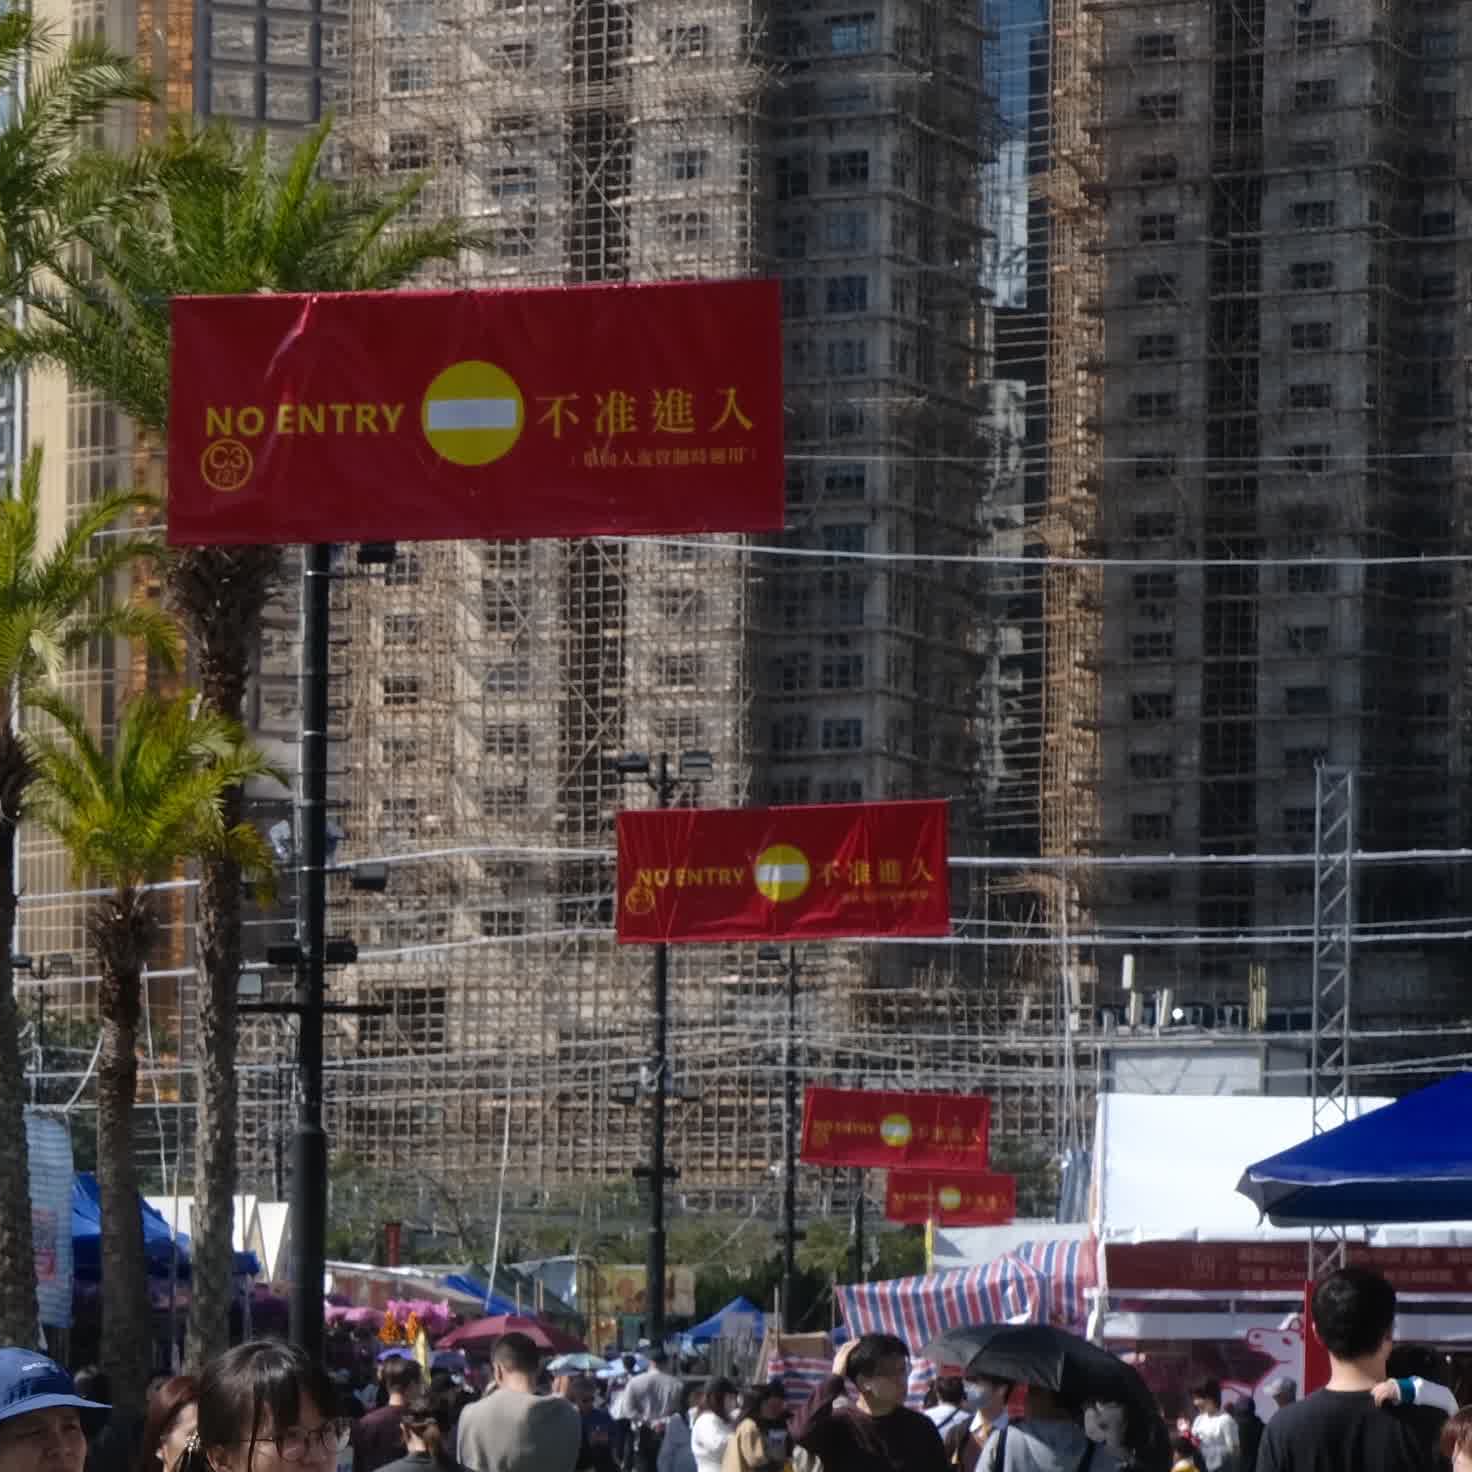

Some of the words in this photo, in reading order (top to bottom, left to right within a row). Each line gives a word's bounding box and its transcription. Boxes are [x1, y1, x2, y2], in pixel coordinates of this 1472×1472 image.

[206, 406, 265, 437] NO
[276, 402, 405, 435] ENTRY
[535, 387, 754, 439] 不准進入
[209, 446, 246, 469] C3
[635, 868, 669, 887] NO
[675, 866, 745, 887] ENTRY
